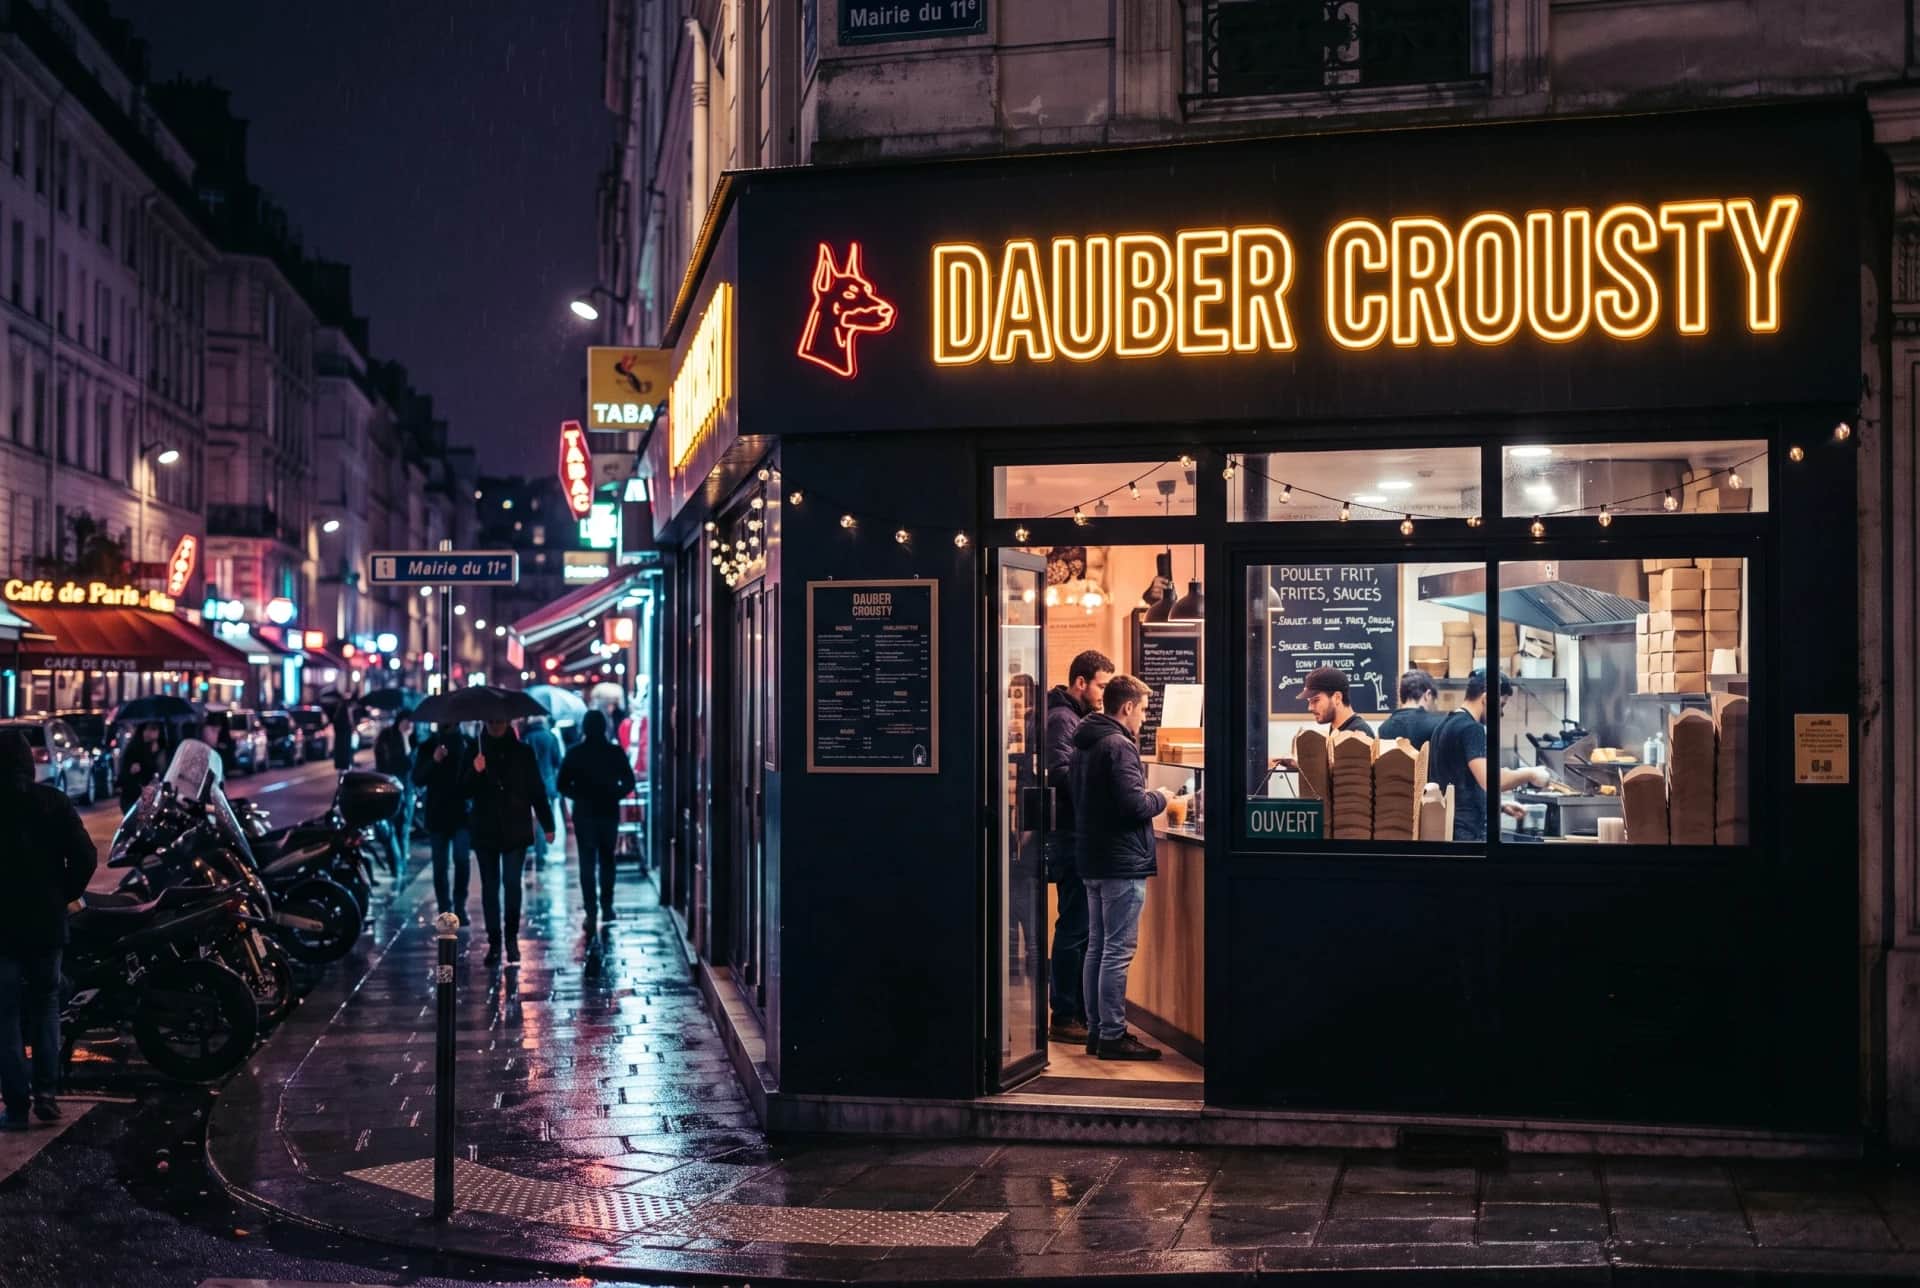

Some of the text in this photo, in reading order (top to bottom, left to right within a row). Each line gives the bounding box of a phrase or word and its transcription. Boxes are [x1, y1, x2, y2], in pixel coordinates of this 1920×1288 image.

[850, 6, 910, 27] Mairie
[919, 3, 942, 21] du
[931, 193, 1802, 366] DAUBER CROUSTY
[593, 403, 655, 423] TABA
[564, 430, 590, 512] TABAC
[408, 560, 457, 575] Mairie
[462, 560, 482, 575] du
[1280, 567, 1379, 584] POULET FRIT,
[4, 579, 54, 602] Café
[58, 581, 85, 603] de
[89, 582, 140, 606] Paris
[853, 592, 892, 605] DAUBER
[1280, 586, 1382, 603] FRITES, SAUCES
[852, 605, 893, 617] CROUSTY
[44, 656, 78, 669] CAFÉ
[81, 658, 98, 670] DE
[1251, 810, 1319, 832] OUVERT
